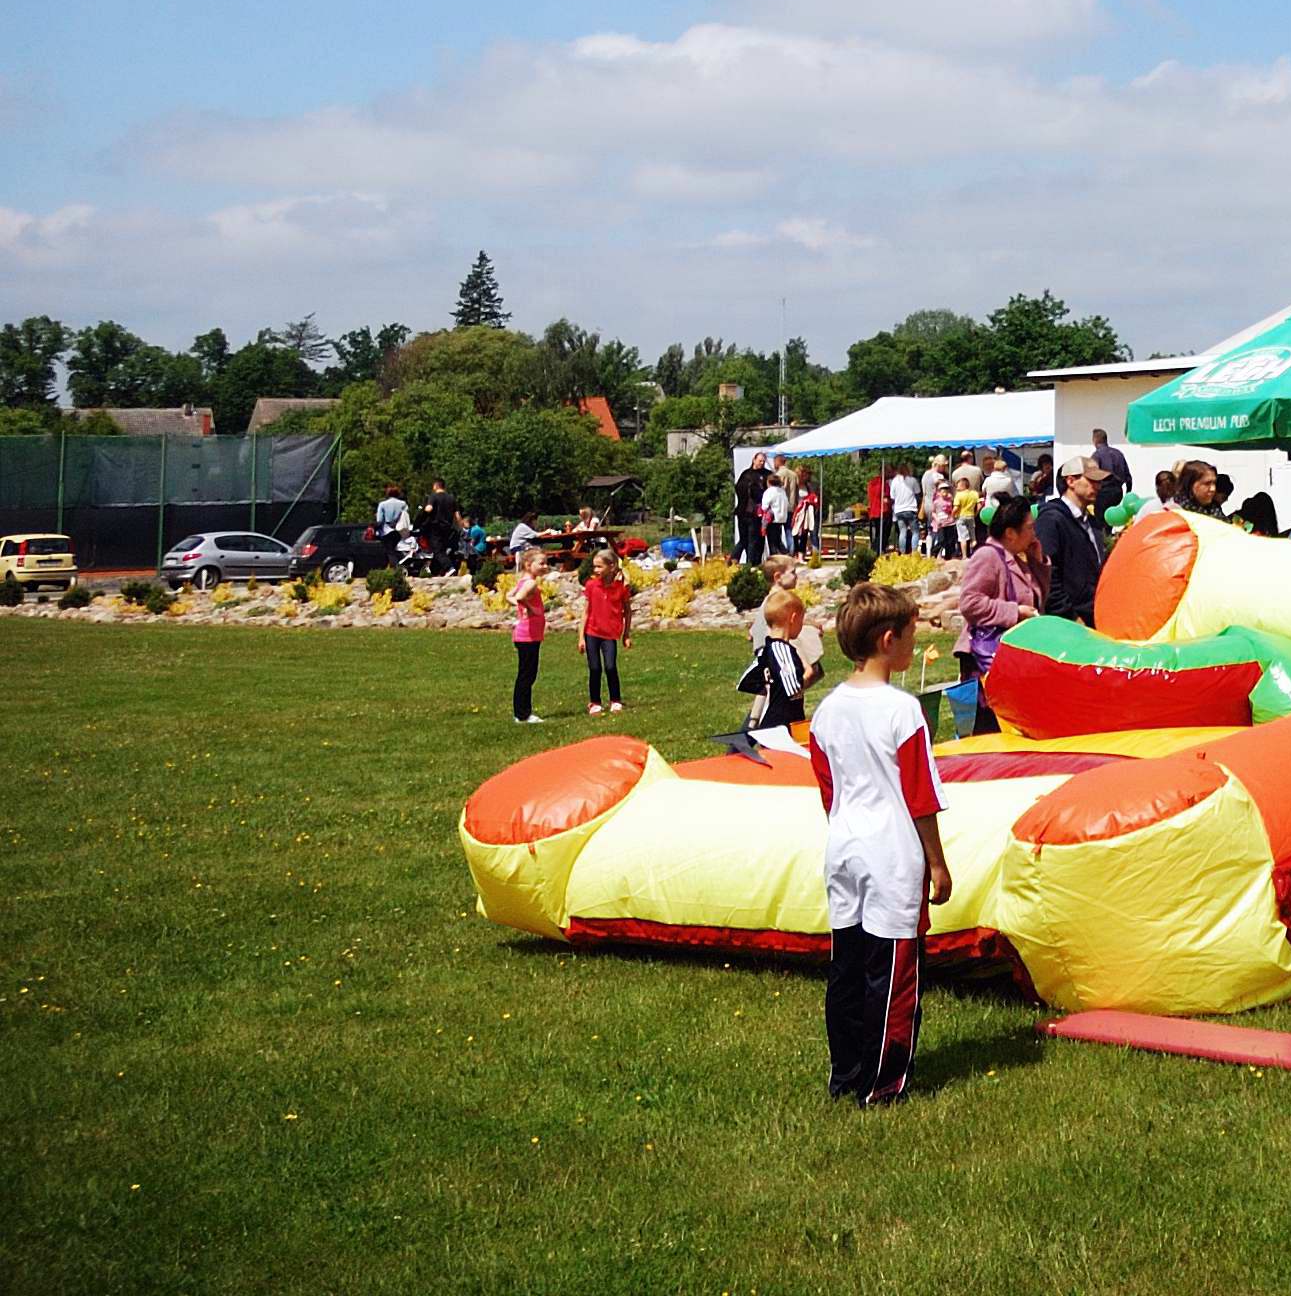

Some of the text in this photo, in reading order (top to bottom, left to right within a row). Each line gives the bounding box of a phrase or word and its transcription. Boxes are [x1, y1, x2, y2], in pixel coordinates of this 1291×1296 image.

[1153, 414, 1250, 432] LECH PREMIUM PUB
